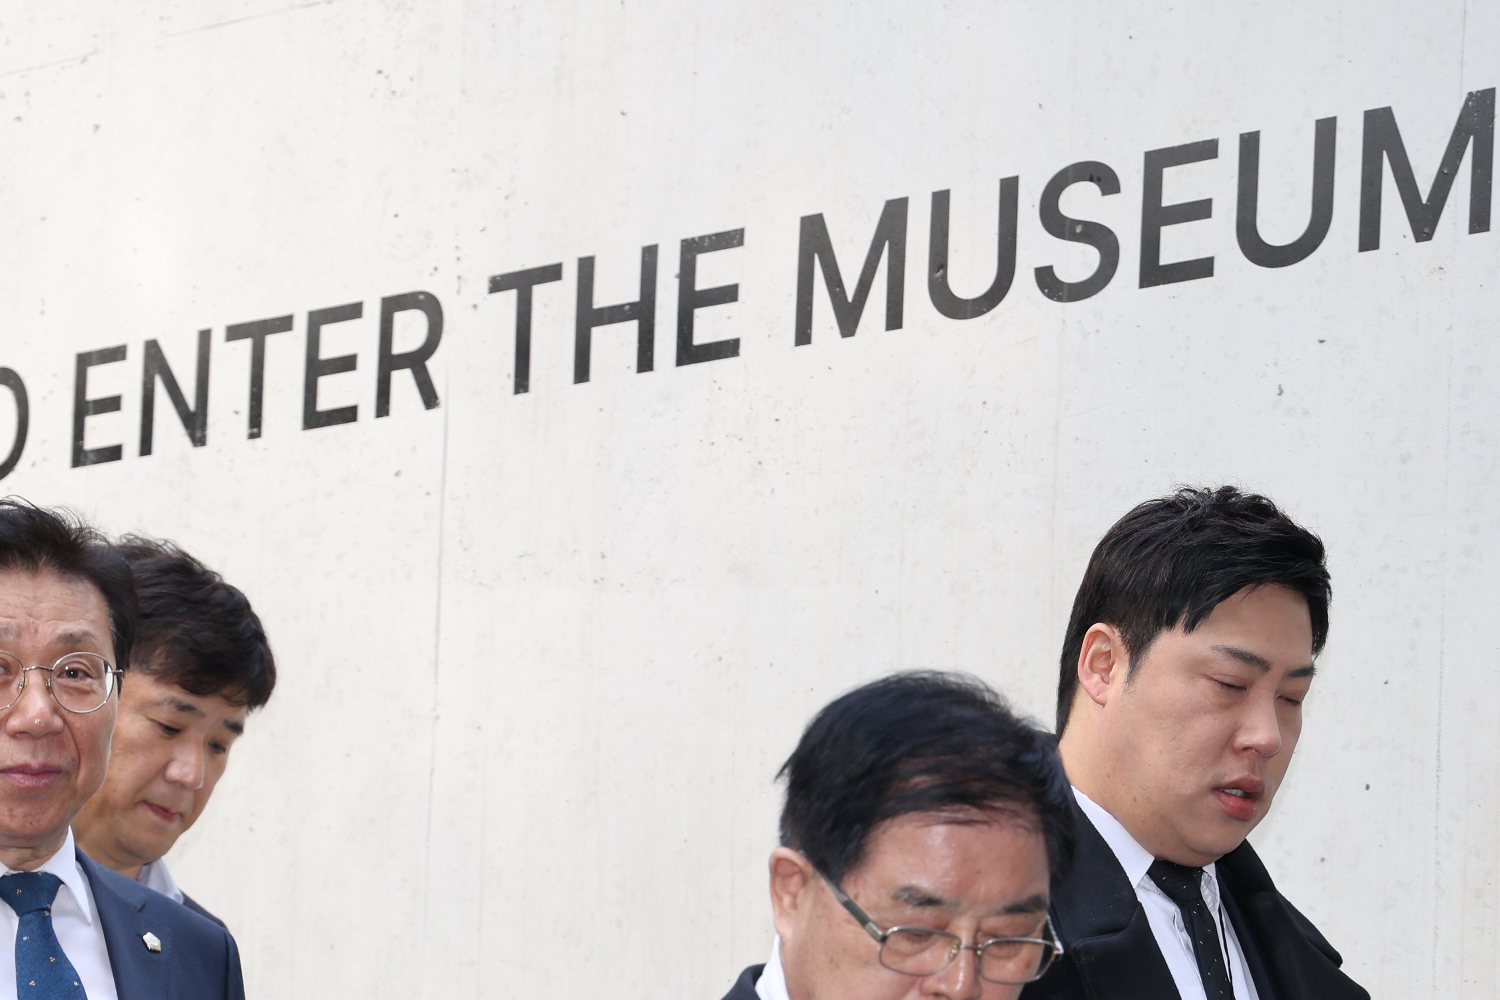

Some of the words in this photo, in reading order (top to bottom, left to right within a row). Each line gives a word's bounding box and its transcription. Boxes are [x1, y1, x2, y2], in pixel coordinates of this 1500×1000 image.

[70, 290, 445, 470] ENTER
[487, 228, 746, 396] THE
[793, 86, 1497, 348] MUSEUM
